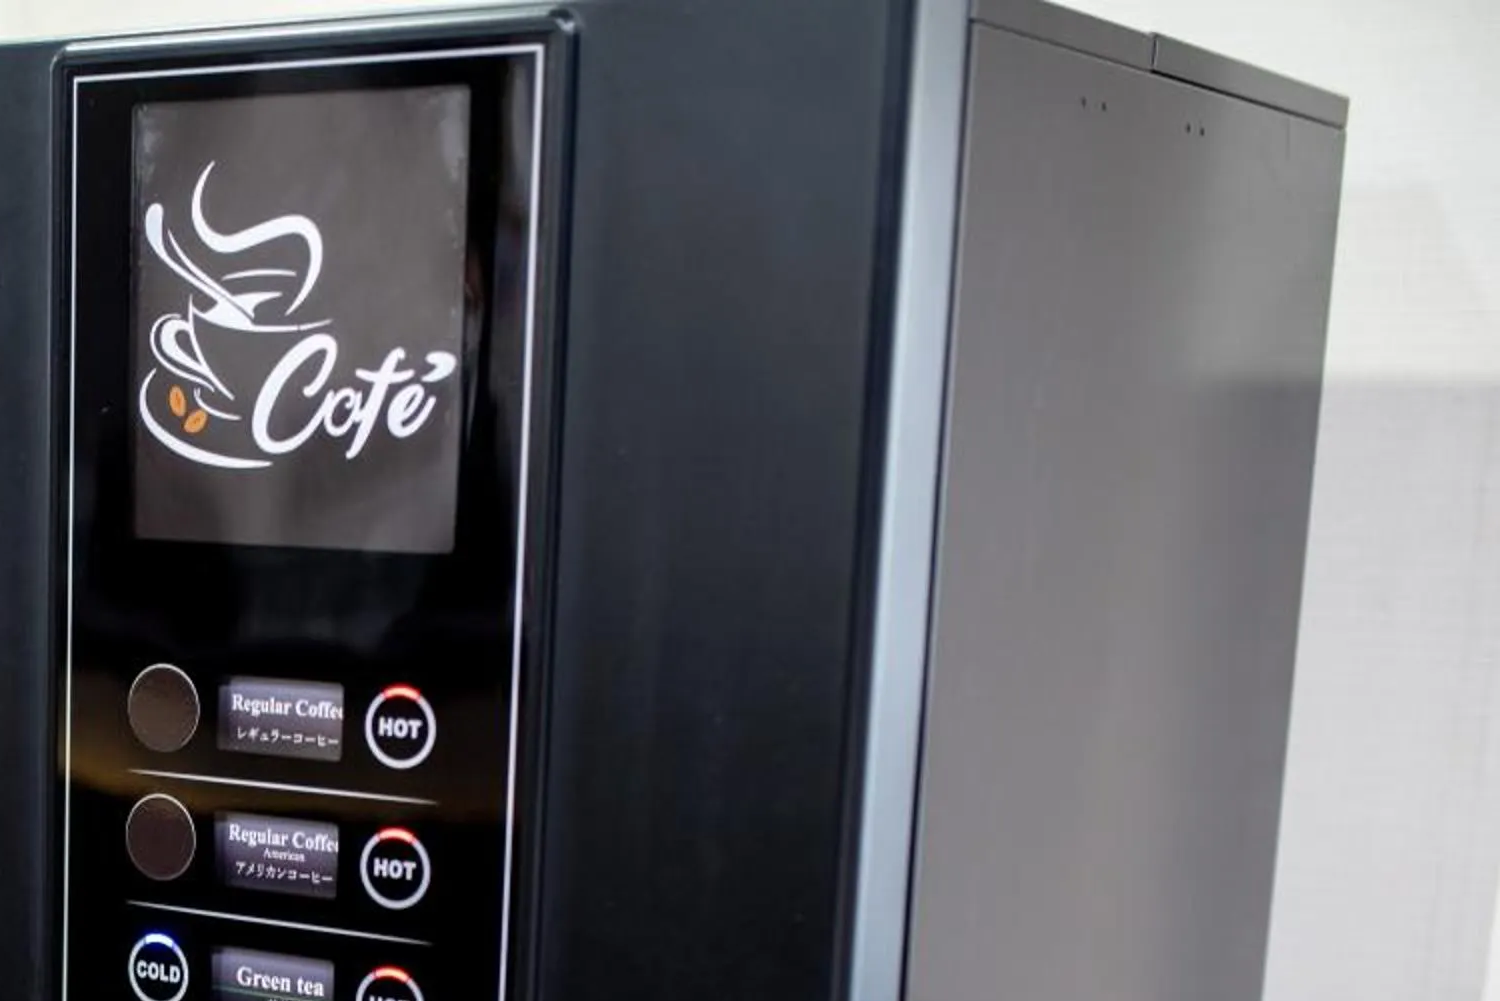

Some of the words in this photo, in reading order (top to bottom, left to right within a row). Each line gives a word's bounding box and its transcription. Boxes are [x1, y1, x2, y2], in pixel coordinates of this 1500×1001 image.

[252, 333, 456, 460] Café
[232, 693, 292, 717] Regular
[237, 727, 339, 747] レギュラーコーヒー
[378, 717, 422, 739] HOT
[229, 823, 289, 848] Regular
[263, 848, 305, 863] American
[236, 861, 333, 885] アメリカンコーヒー
[374, 858, 416, 880] HOT
[137, 960, 180, 984] COLD
[237, 965, 291, 993] Green
[297, 976, 324, 997] tea
